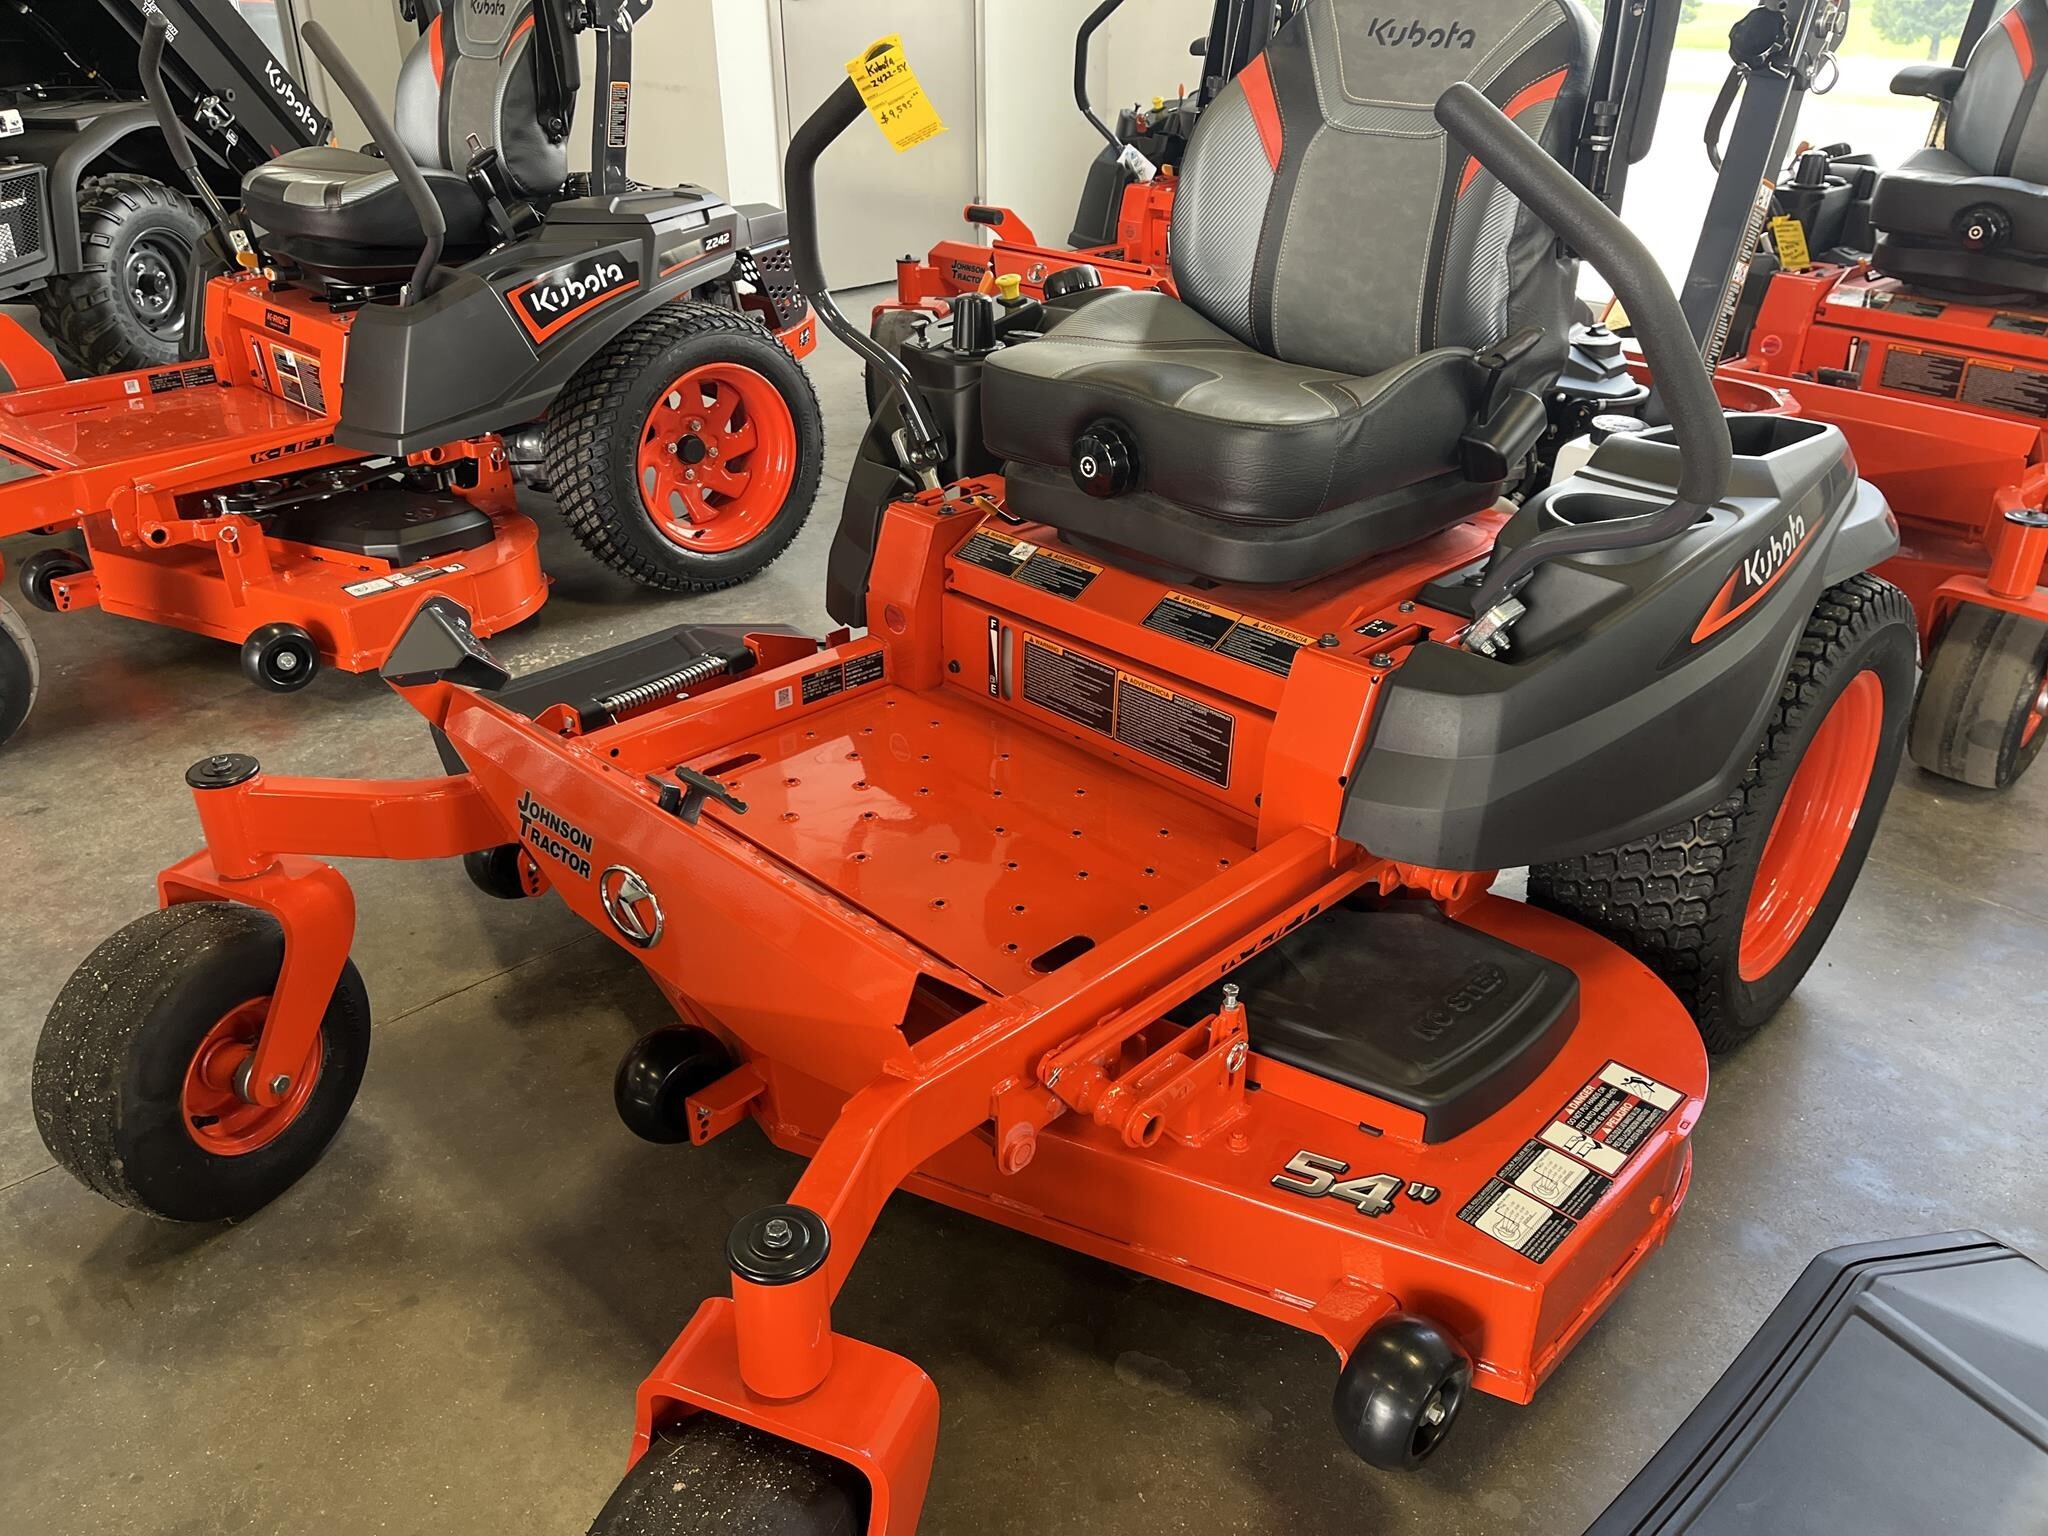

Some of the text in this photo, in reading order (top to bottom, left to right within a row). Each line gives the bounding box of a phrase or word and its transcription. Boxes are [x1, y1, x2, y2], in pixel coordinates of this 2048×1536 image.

[1367, 17, 1476, 49] Kubota
[264, 59, 318, 136] Kubota
[705, 232, 731, 251] Z242
[530, 262, 624, 312] Kubota
[253, 434, 330, 464] K-LIFT
[1744, 514, 1805, 586] Kubota
[1181, 597, 1211, 611] WARNING
[1260, 623, 1308, 644] ADVERTENCIA
[1129, 677, 1170, 699] ADVERTENCIA
[517, 791, 593, 853] JOHNSON
[519, 814, 592, 880] TRACTOR
[1567, 1084, 1596, 1110] DANGER
[1605, 1101, 1633, 1128] PELIGRO
[1271, 1149, 1441, 1218] 54"
